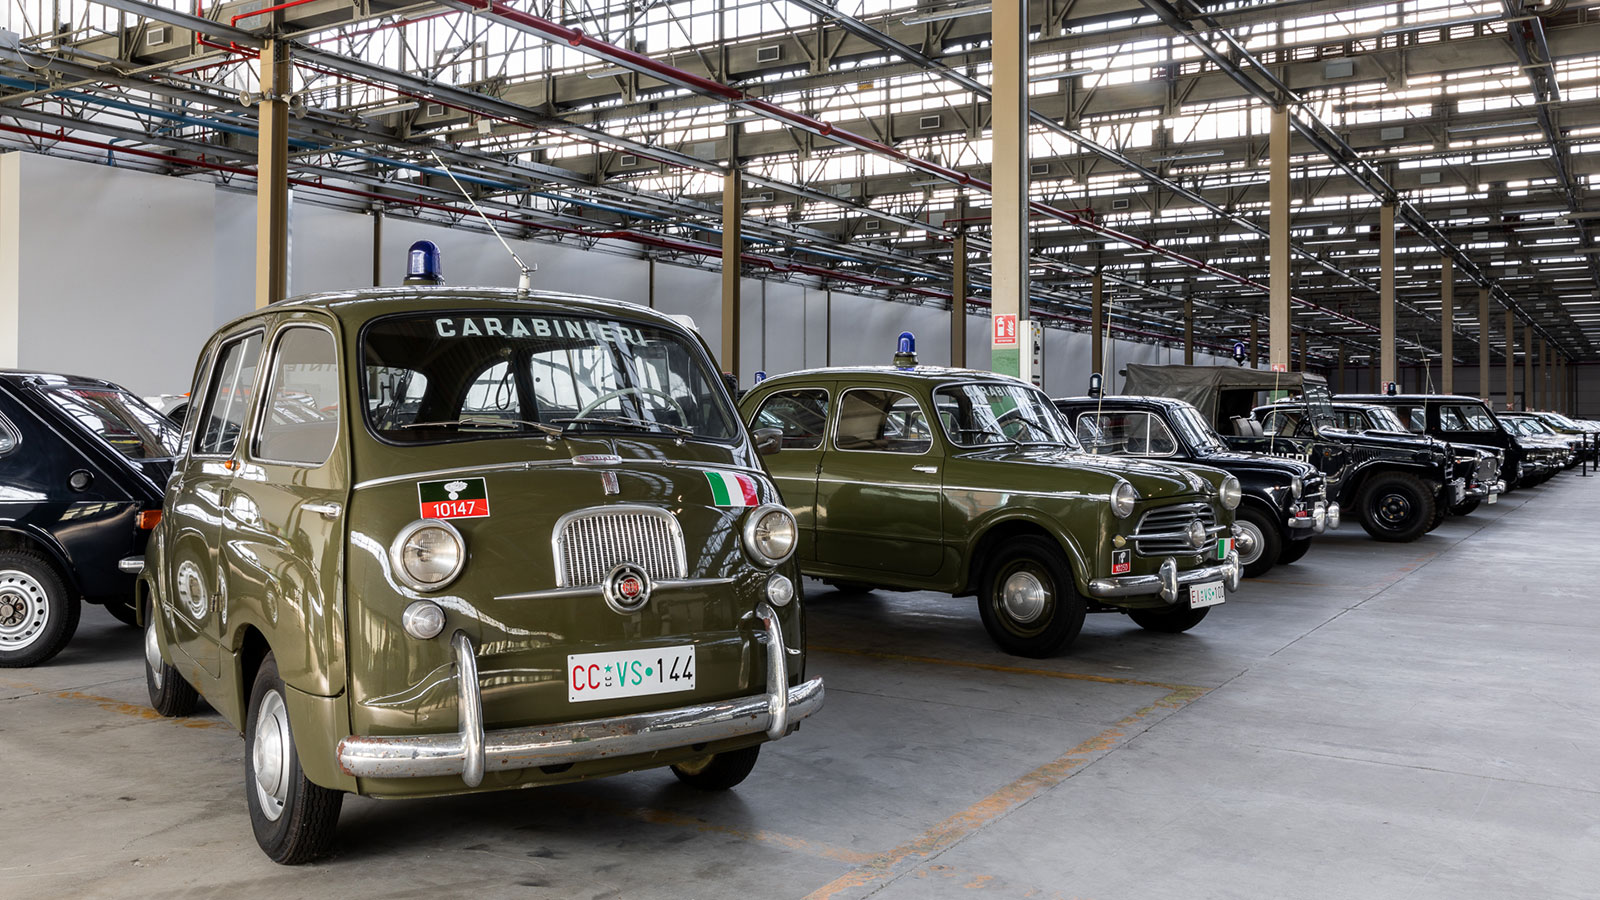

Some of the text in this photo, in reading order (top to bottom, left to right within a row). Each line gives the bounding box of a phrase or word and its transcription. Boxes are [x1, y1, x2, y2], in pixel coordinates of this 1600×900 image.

[435, 318, 648, 347] CARABINIERI
[963, 385, 1035, 400] CARABINRI
[433, 501, 476, 517] 10147
[572, 655, 693, 691] CC VS 144
